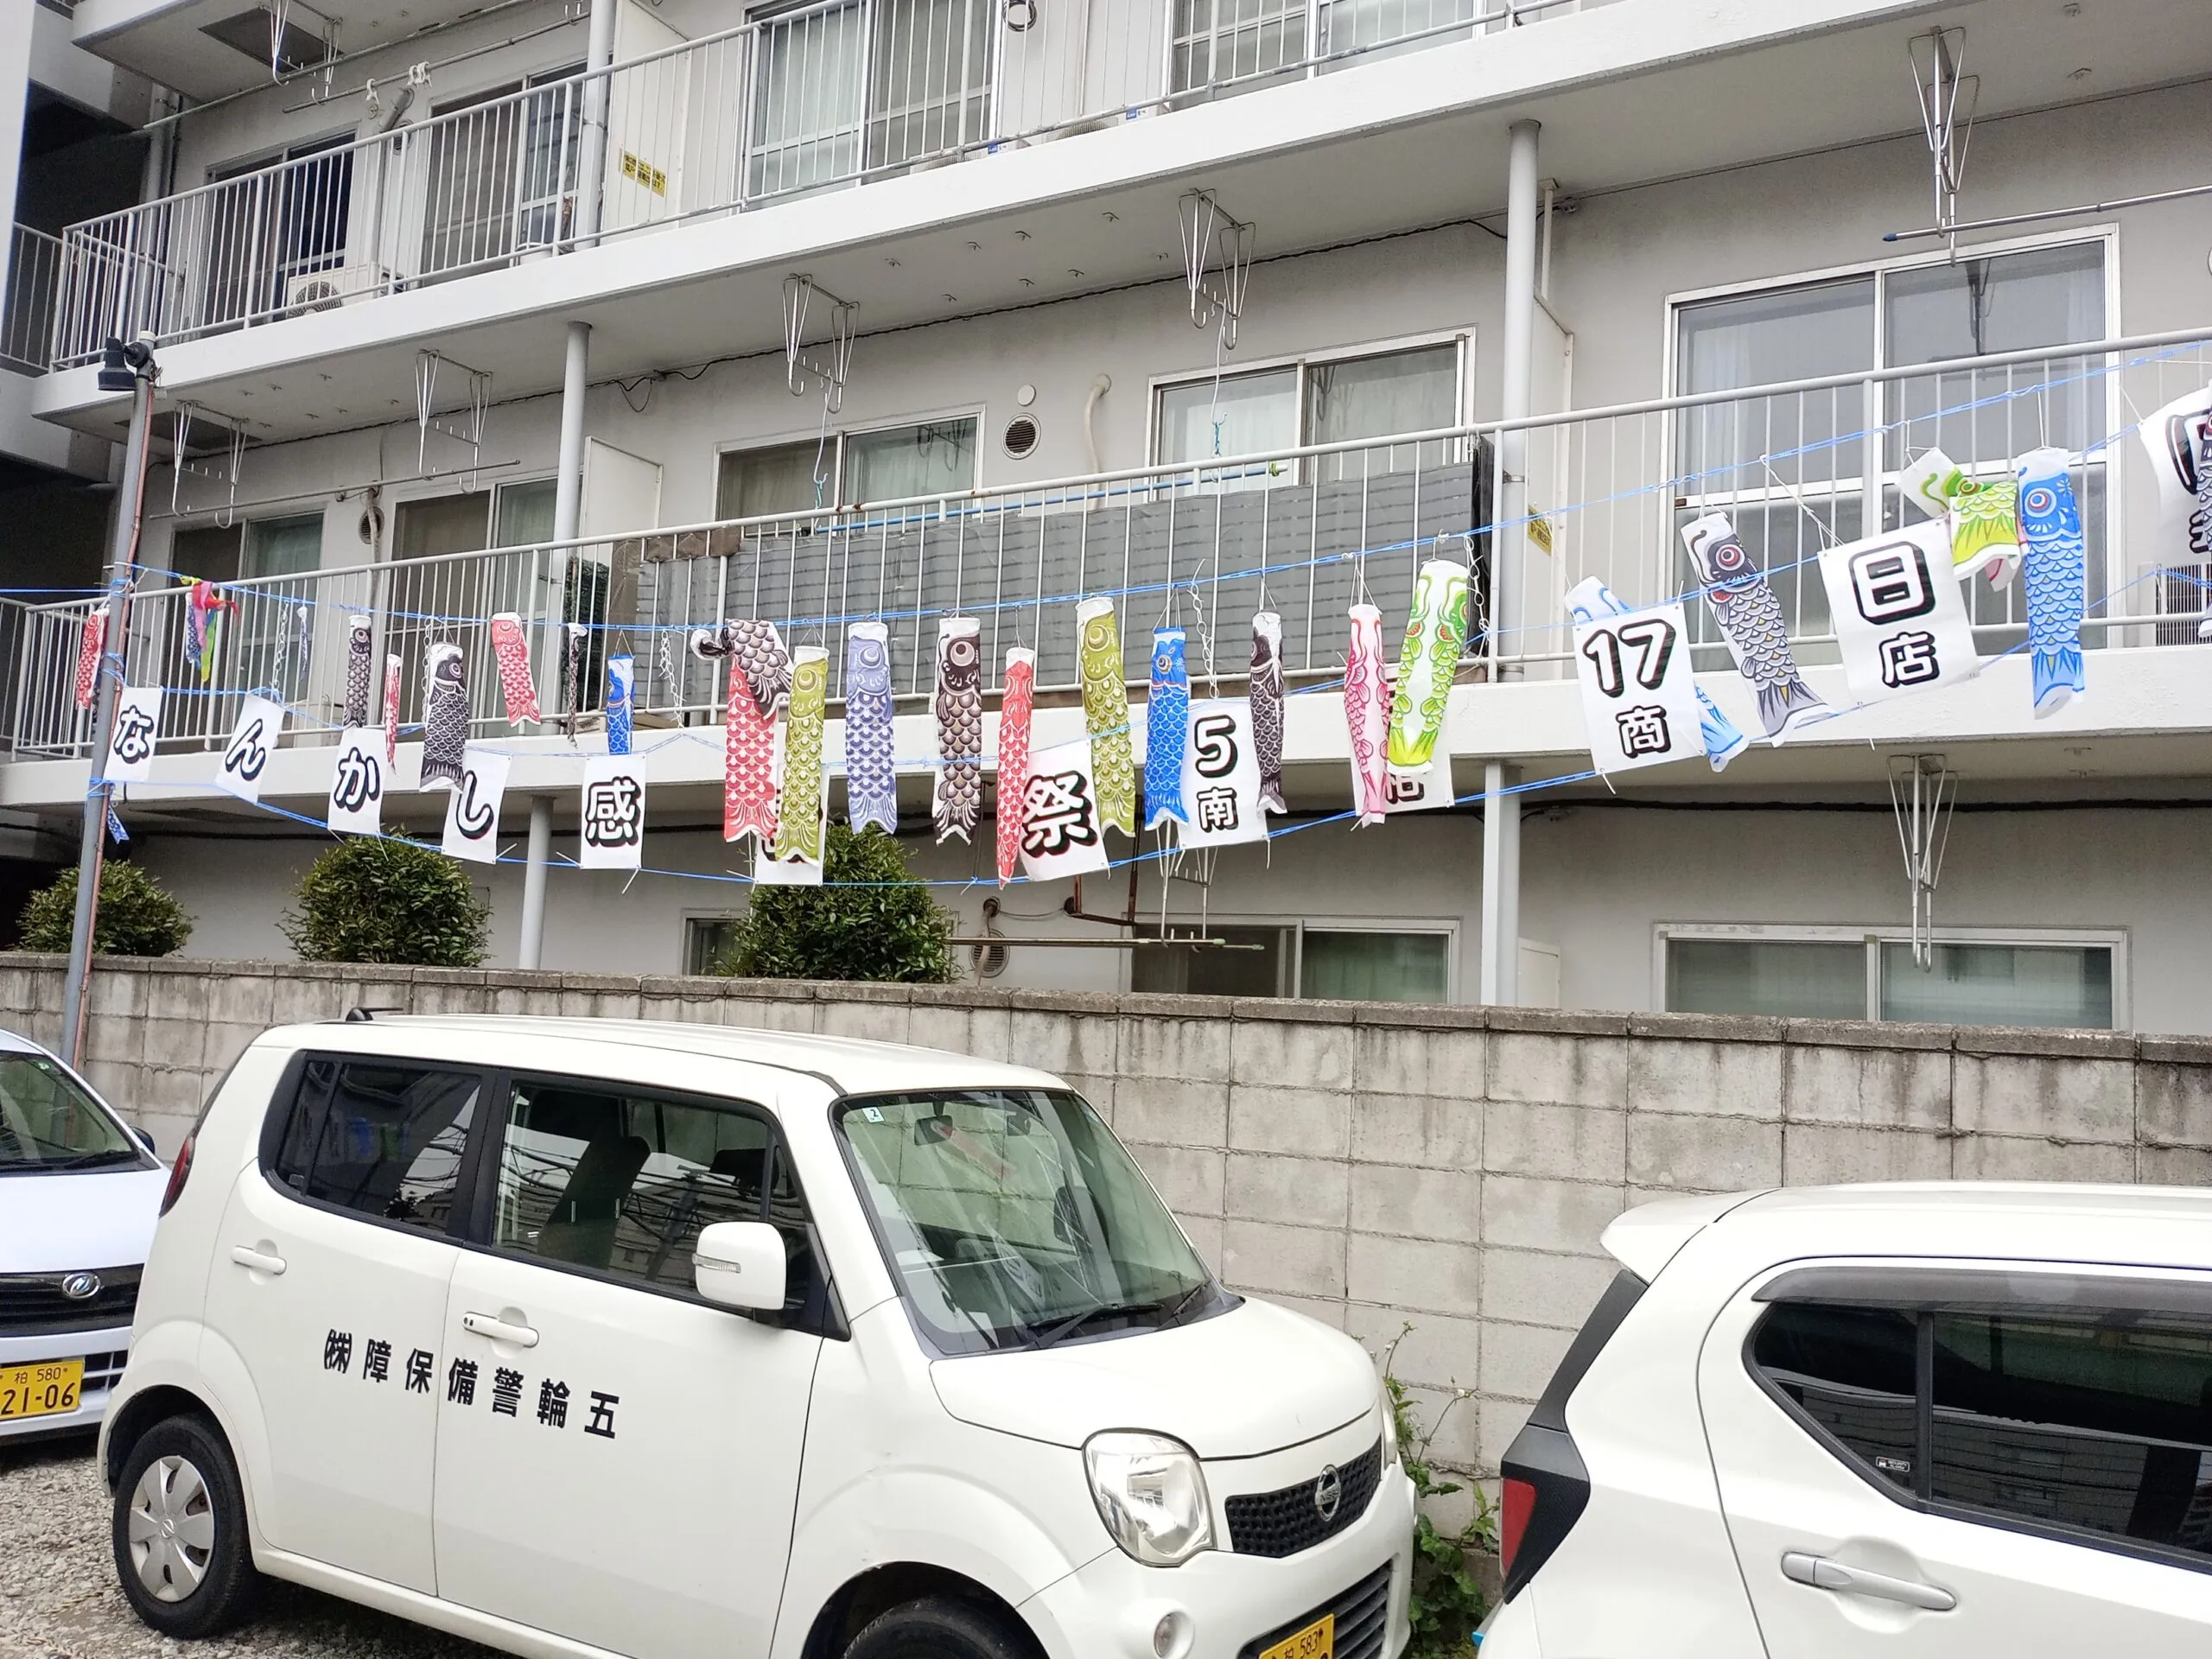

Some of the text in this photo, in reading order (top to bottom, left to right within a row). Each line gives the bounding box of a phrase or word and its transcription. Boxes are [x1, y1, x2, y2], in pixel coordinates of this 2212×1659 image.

[1848, 541, 1936, 626] 日
[1582, 619, 1676, 698] 17
[1878, 631, 1941, 689] 店
[113, 704, 155, 764] な
[225, 718, 266, 782] ん
[1194, 714, 1238, 779] 5
[1615, 705, 1672, 759] 商
[334, 747, 380, 813] か
[455, 770, 494, 840] し
[585, 776, 642, 847] 感
[1196, 786, 1239, 833] 南
[1021, 770, 1098, 858] 祭
[1, 1382, 75, 1415] 21-06
[36, 1367, 61, 1382] 580
